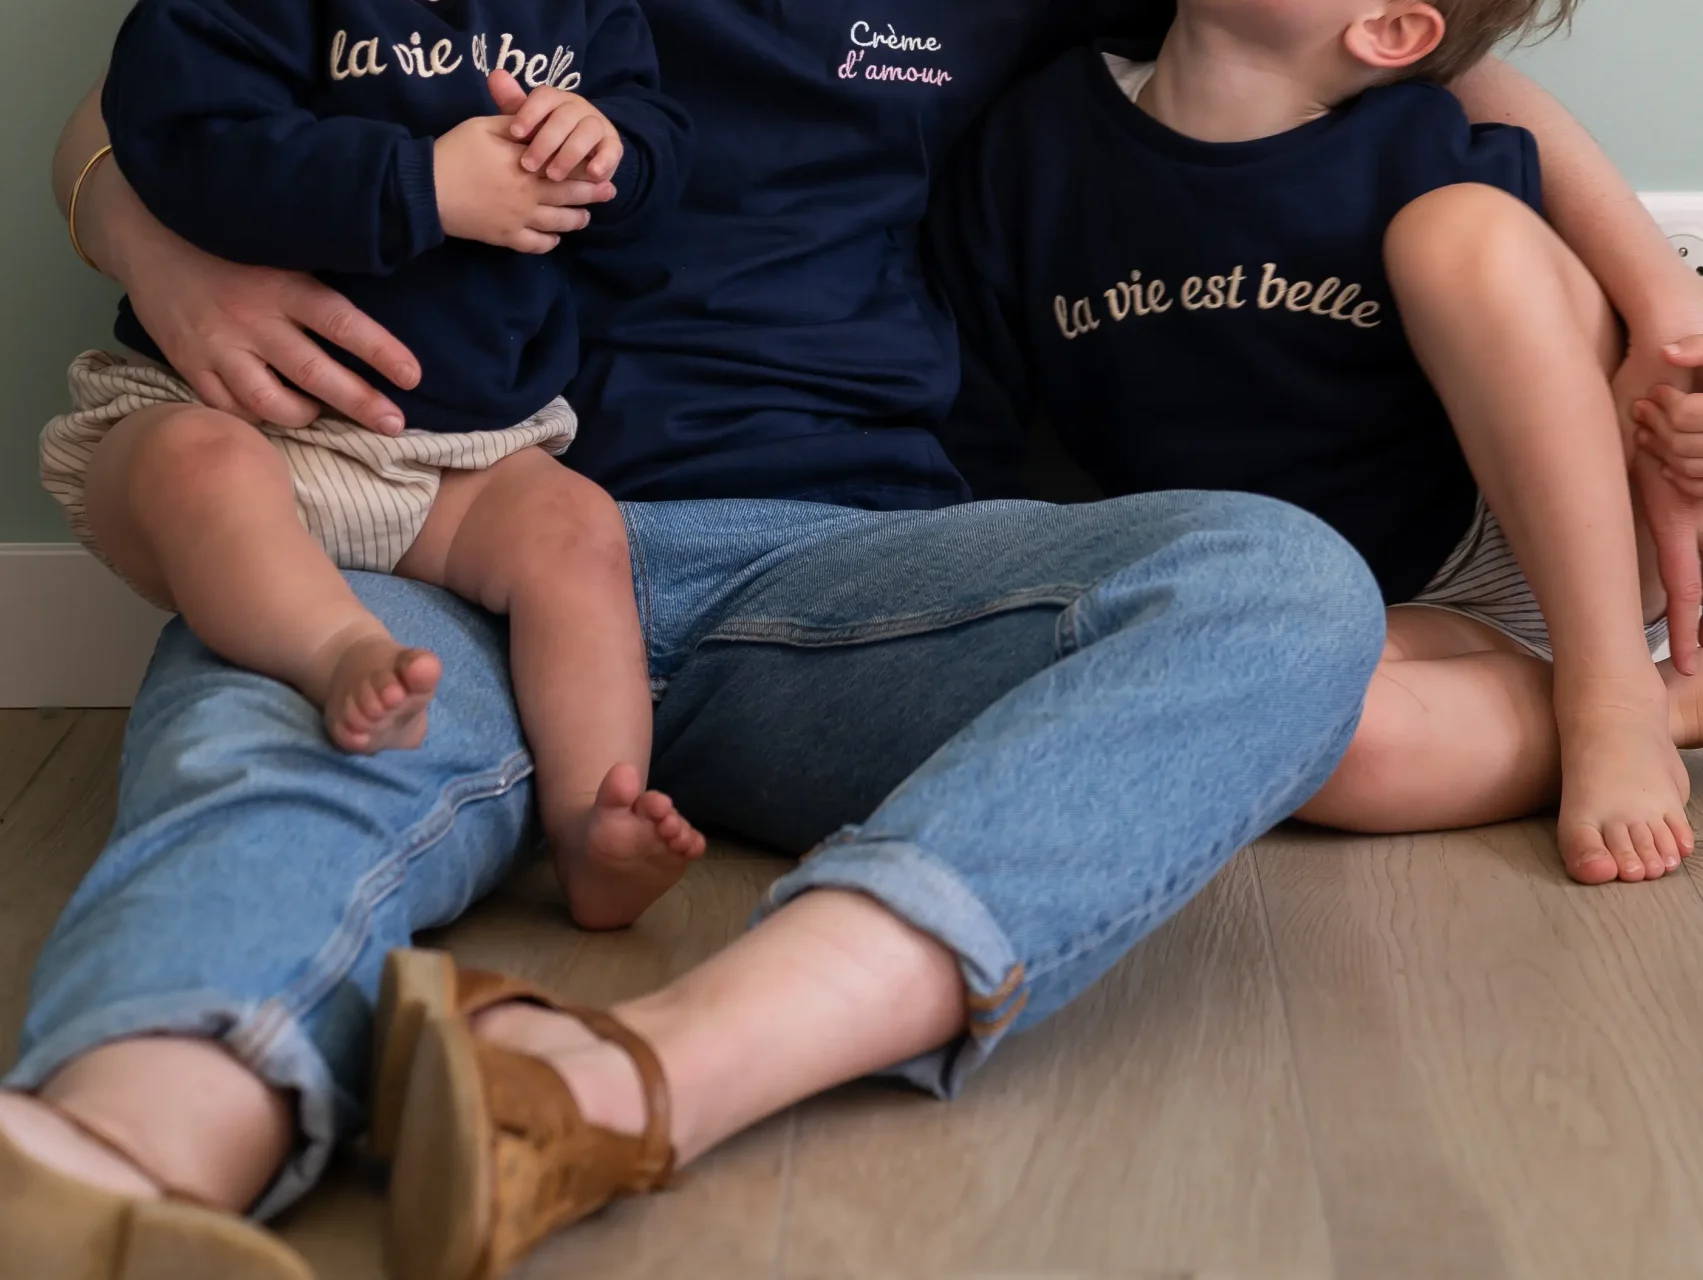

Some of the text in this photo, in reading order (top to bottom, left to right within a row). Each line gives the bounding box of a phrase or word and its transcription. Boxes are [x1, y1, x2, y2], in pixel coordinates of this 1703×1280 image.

[329, 29, 388, 81] la
[392, 31, 464, 78] vie
[849, 20, 942, 52] Crème
[838, 49, 953, 87] d'amour
[1053, 262, 1382, 340] la vie est belle
